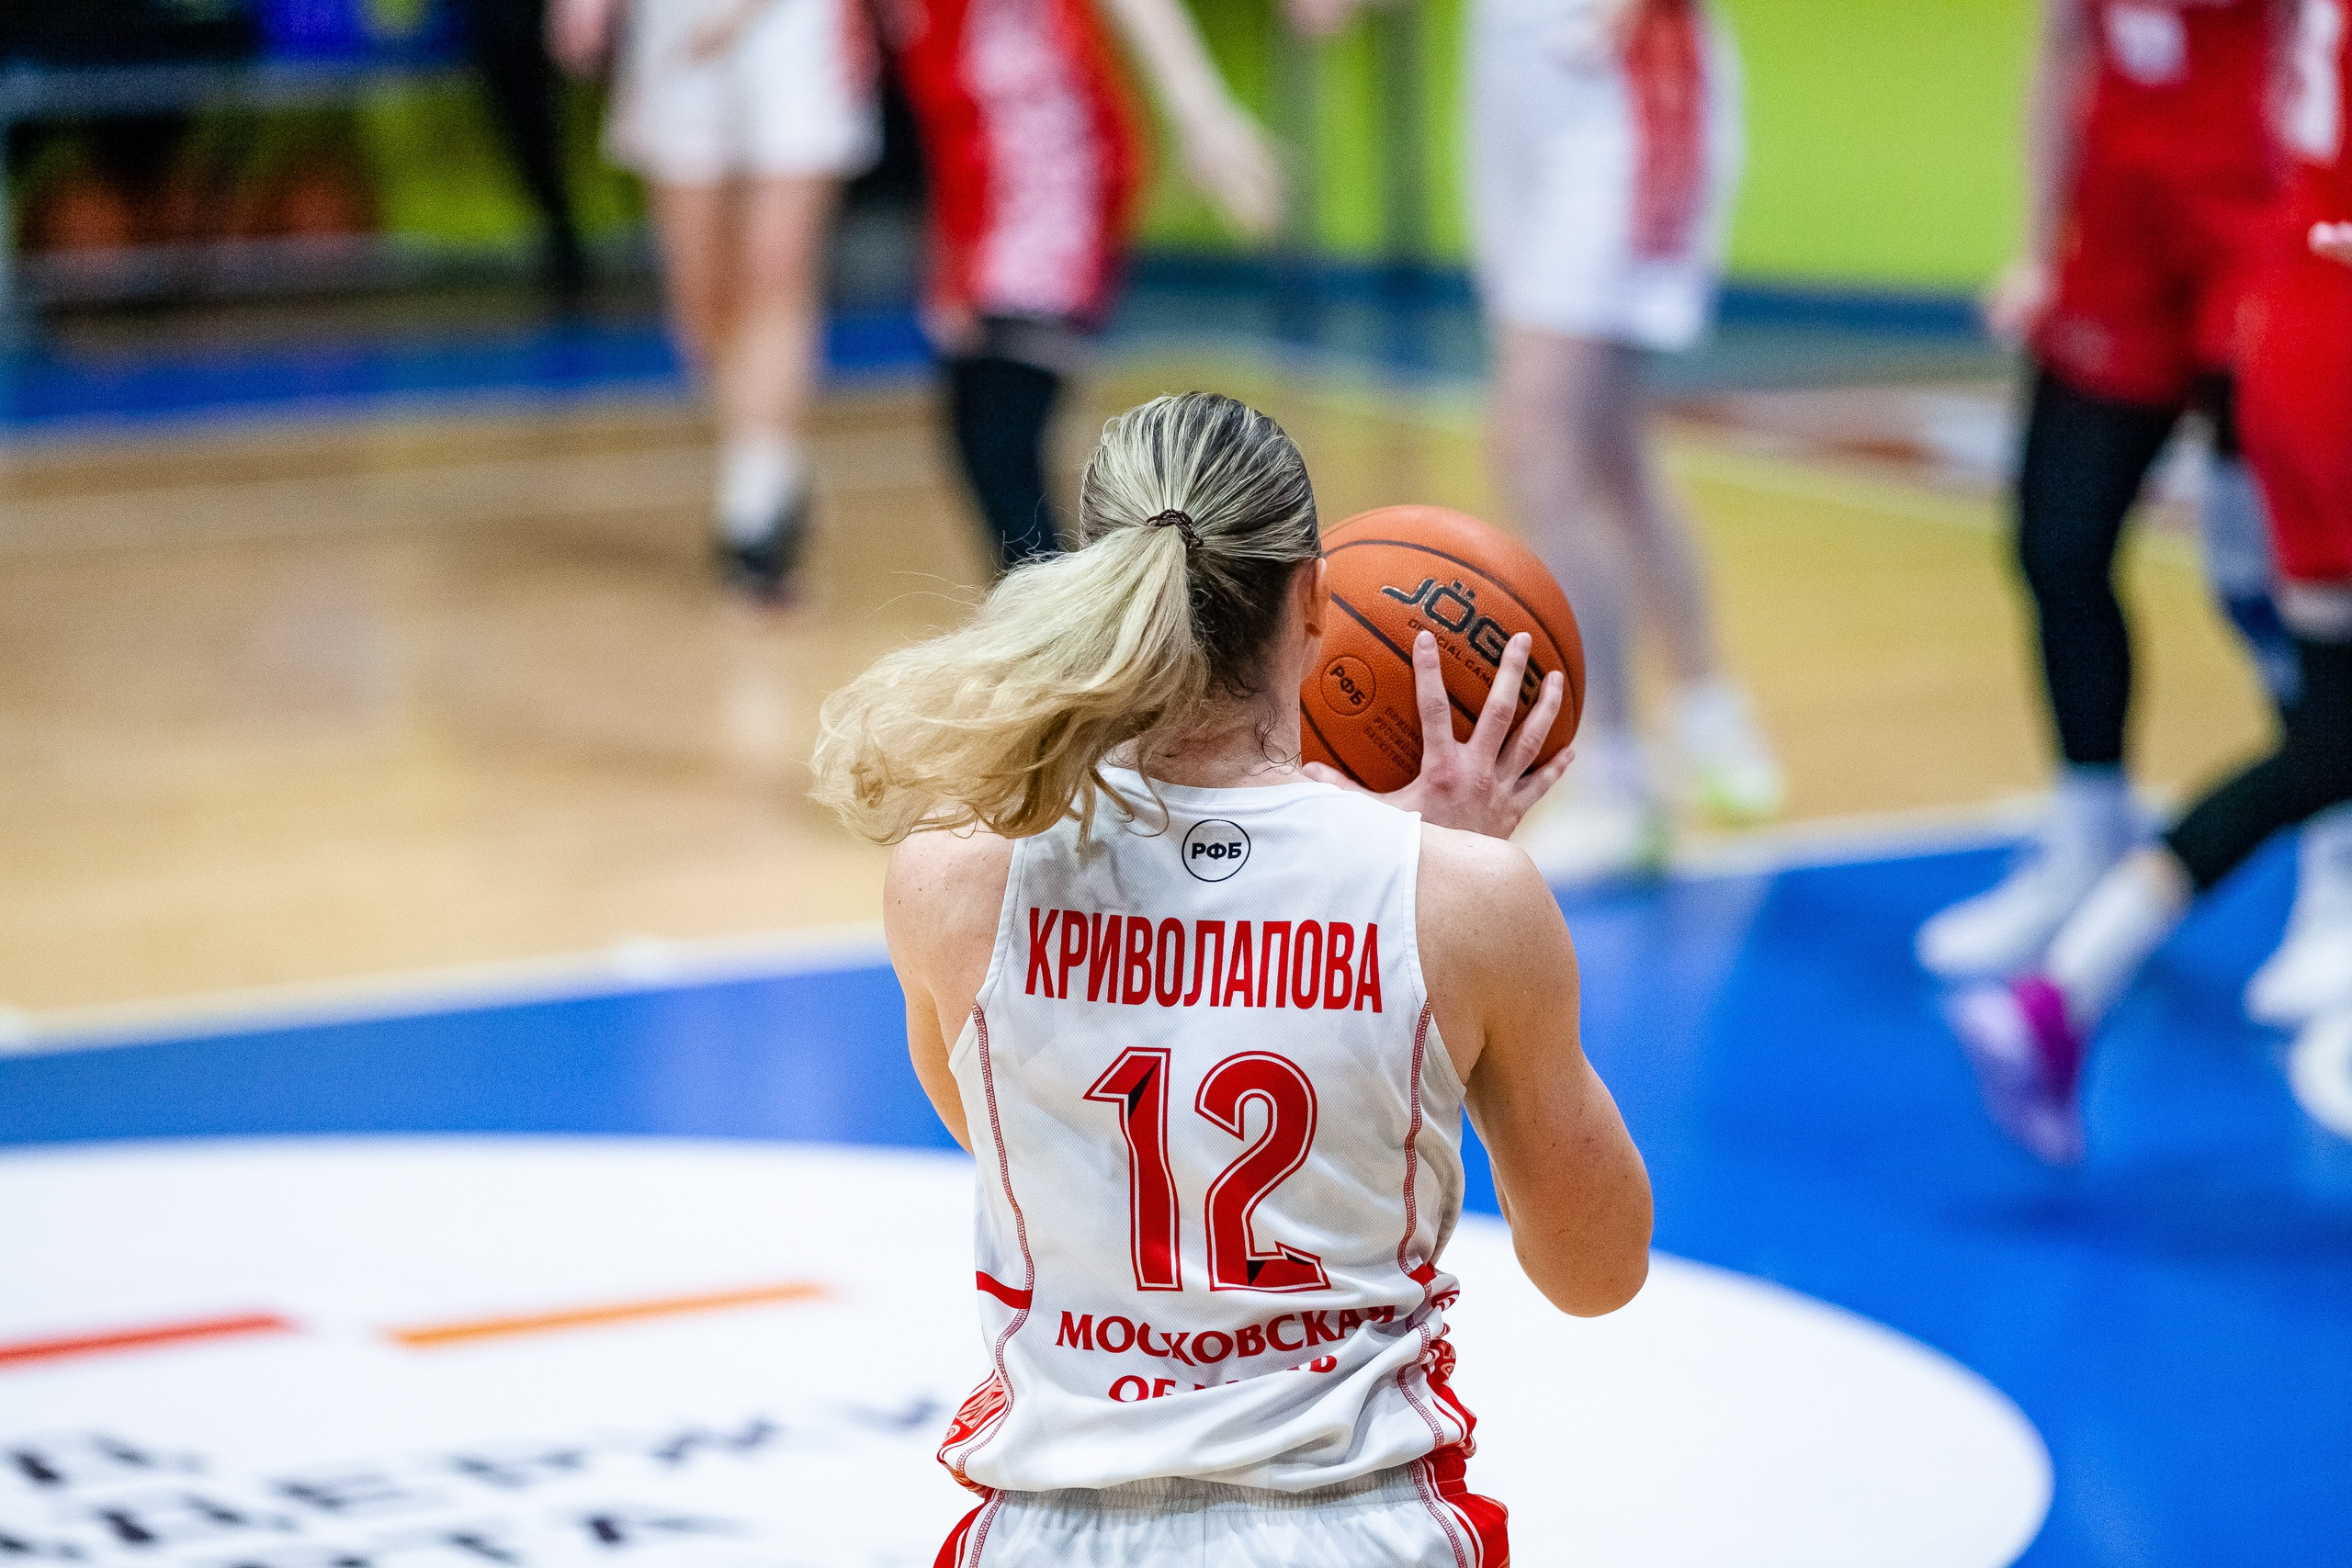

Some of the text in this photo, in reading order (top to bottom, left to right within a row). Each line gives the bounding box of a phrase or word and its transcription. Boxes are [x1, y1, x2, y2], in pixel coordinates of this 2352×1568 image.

[1329, 664, 1365, 705] РФБ
[1192, 842, 1242, 860] РФБ
[1025, 908, 1383, 1013] КРИВОЛАПОВА
[1082, 1046, 1331, 1292] 12
